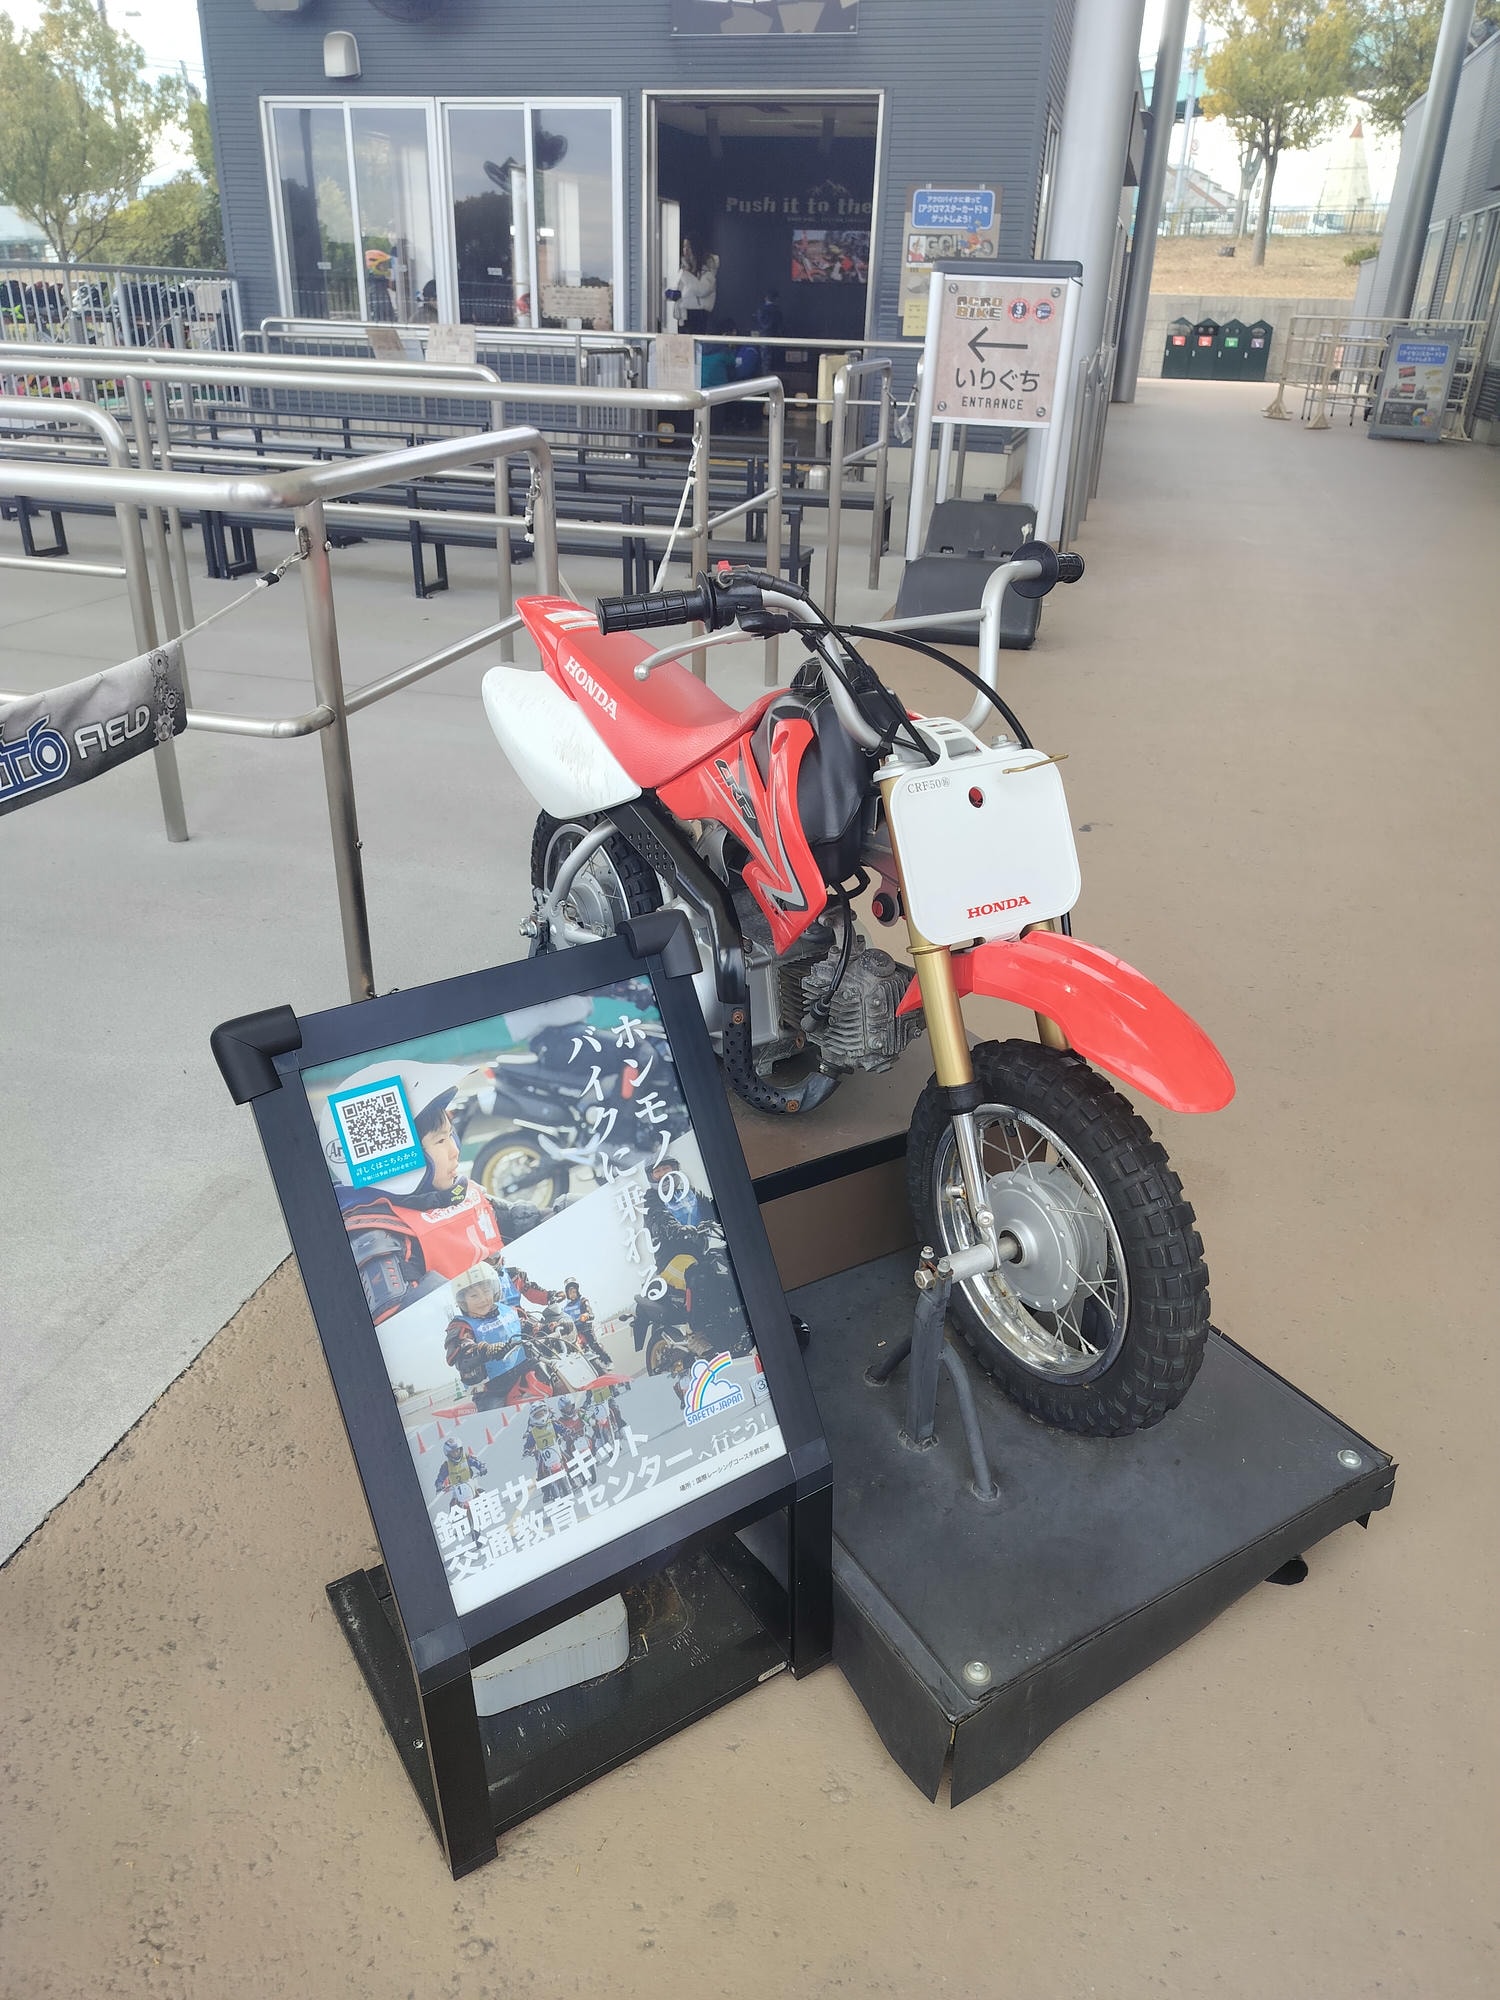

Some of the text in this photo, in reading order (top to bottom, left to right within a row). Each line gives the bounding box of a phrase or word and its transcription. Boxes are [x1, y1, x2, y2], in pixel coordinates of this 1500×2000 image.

[726, 197, 872, 215] Push it to the
[956, 307, 1002, 318] BIKE
[957, 296, 1002, 307] ACRO
[955, 367, 1040, 393] いりぐち
[961, 396, 1024, 410] ENTRANCE
[563, 655, 618, 720] HONDA
[74, 704, 151, 760] FIELD
[714, 758, 757, 820] CRF
[966, 895, 1032, 920] HONDA
[610, 1014, 690, 1202] ホンモノの
[356, 1150, 418, 1177] 詳しくはこちらから
[567, 1025, 668, 1301] バイクに乗れる
[686, 1392, 745, 1426] SAFETY-JAPAN
[434, 1424, 649, 1548] 鈴鹿サーキット
